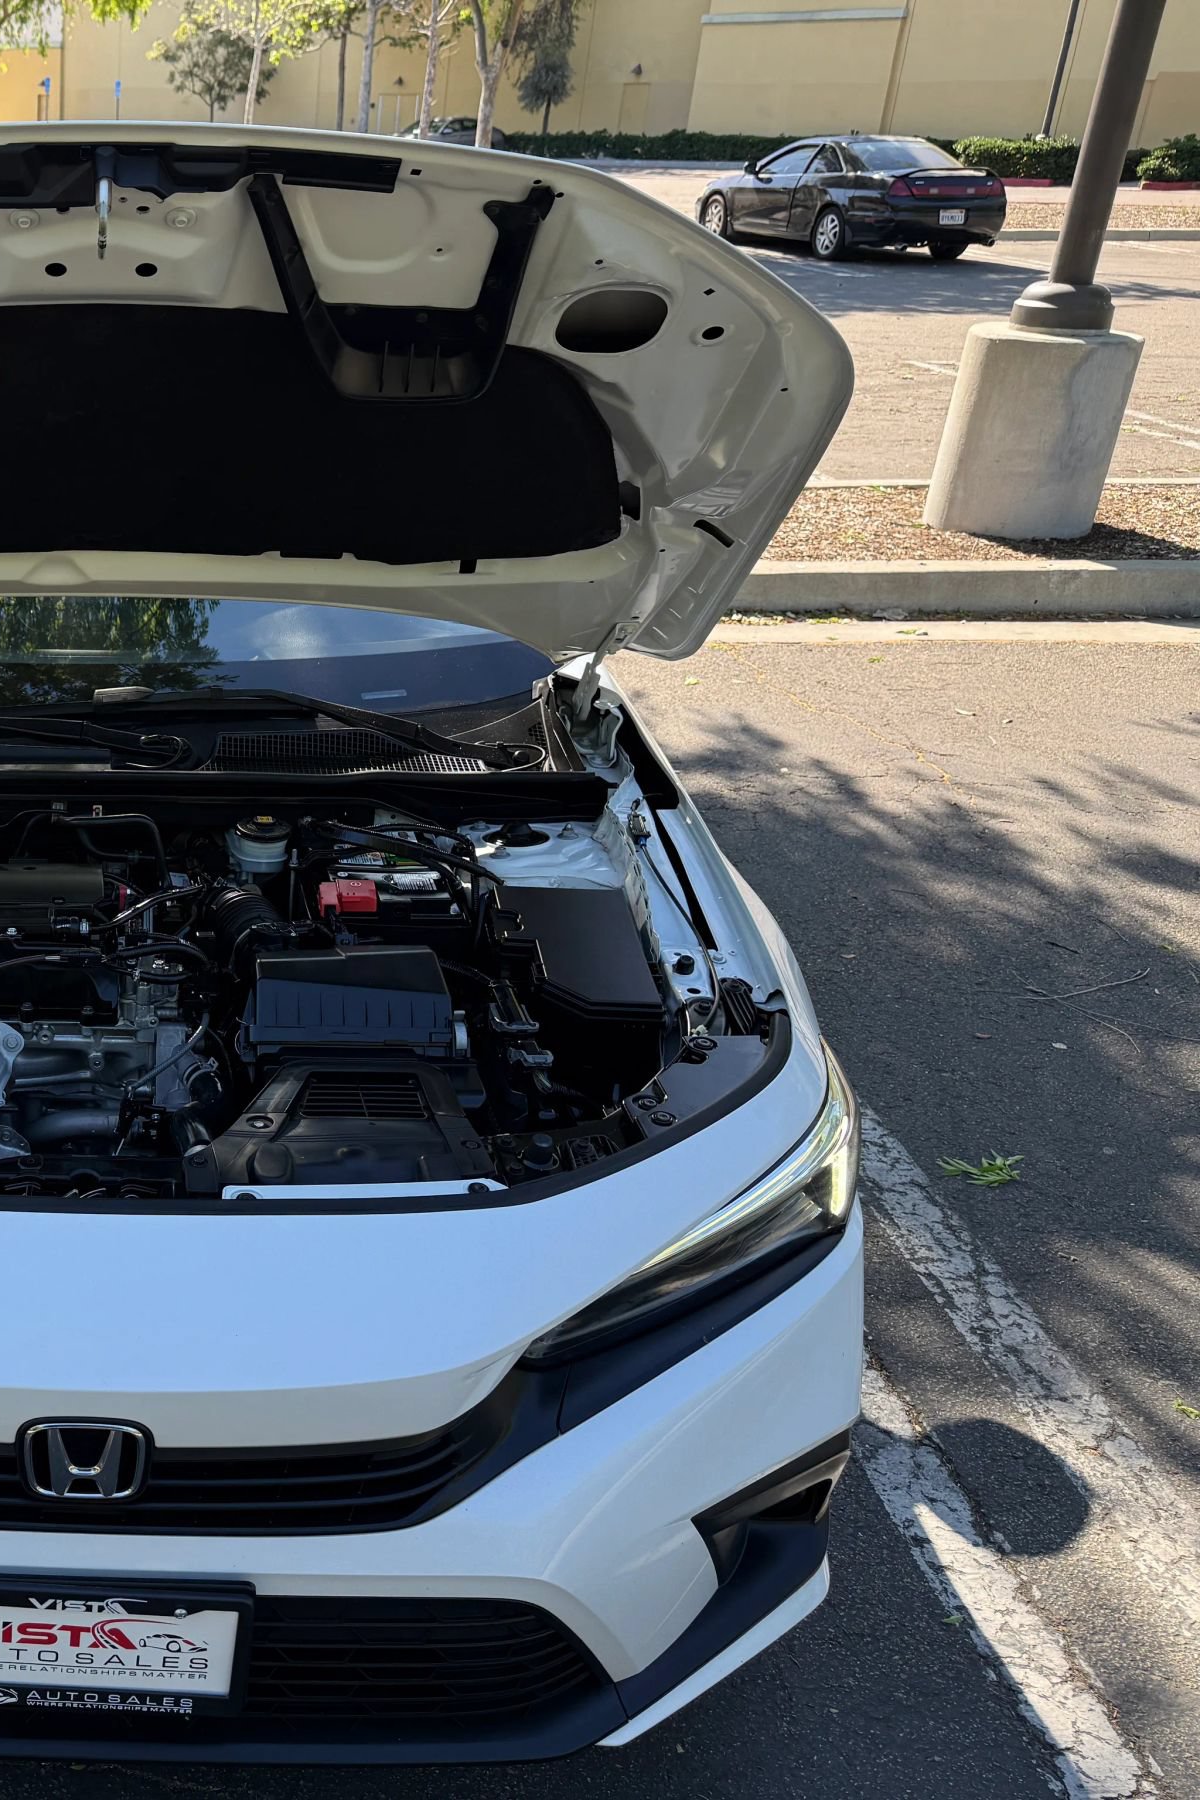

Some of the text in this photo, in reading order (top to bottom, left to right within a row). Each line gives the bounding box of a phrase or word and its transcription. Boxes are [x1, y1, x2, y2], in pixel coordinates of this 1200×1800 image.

[28, 1597, 129, 1614] VISTA
[75, 1653, 208, 1670] SALES
[142, 1671, 207, 1680] MATTER
[26, 1690, 193, 1707] AUTO SALES
